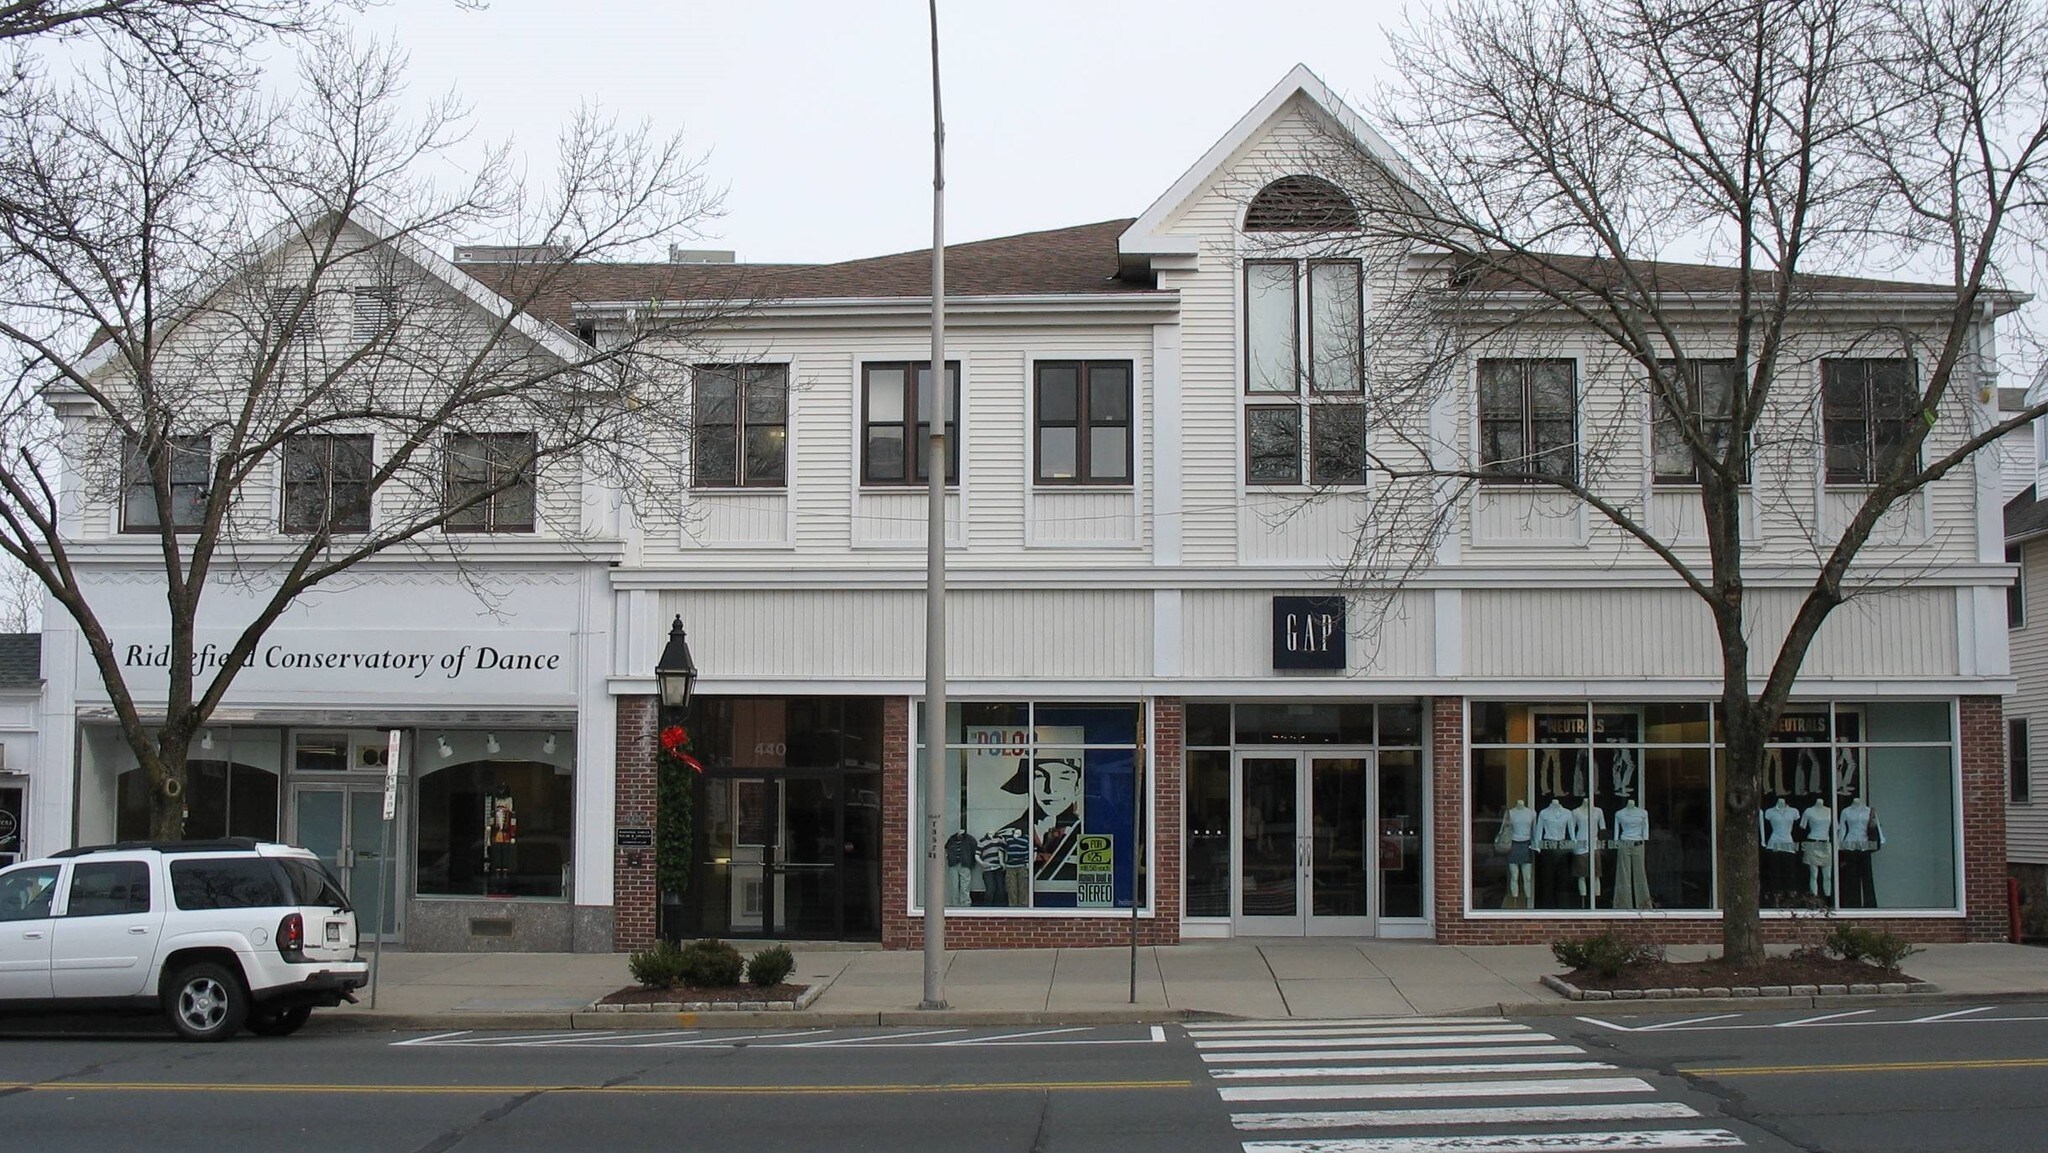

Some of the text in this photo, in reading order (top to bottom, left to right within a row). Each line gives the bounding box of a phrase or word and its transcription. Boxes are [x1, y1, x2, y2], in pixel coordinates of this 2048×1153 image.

[1286, 613, 1332, 652] GAP
[125, 644, 560, 679] Ridefied Conservatory of Dance
[754, 742, 787, 756] 440
[1090, 839, 1103, 849] FOR
[1078, 883, 1113, 903] STEREO
